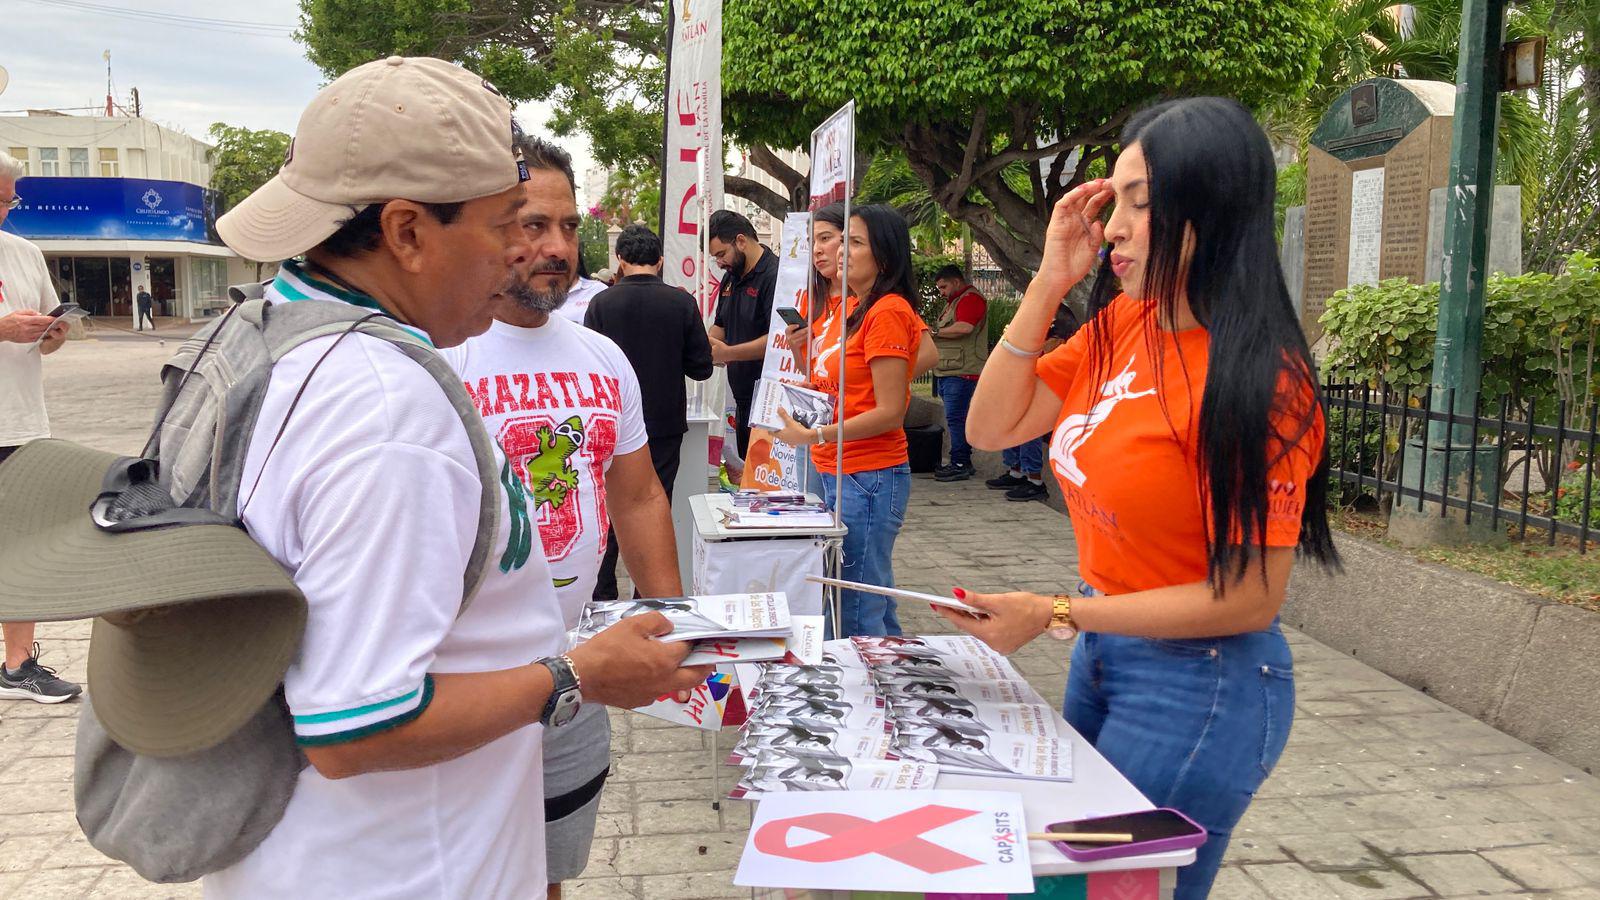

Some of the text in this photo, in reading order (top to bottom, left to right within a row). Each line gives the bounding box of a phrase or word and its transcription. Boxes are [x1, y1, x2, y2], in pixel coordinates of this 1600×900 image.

[779, 356, 792, 373] LA
[755, 467, 767, 481] 10
[768, 472, 779, 485] de
